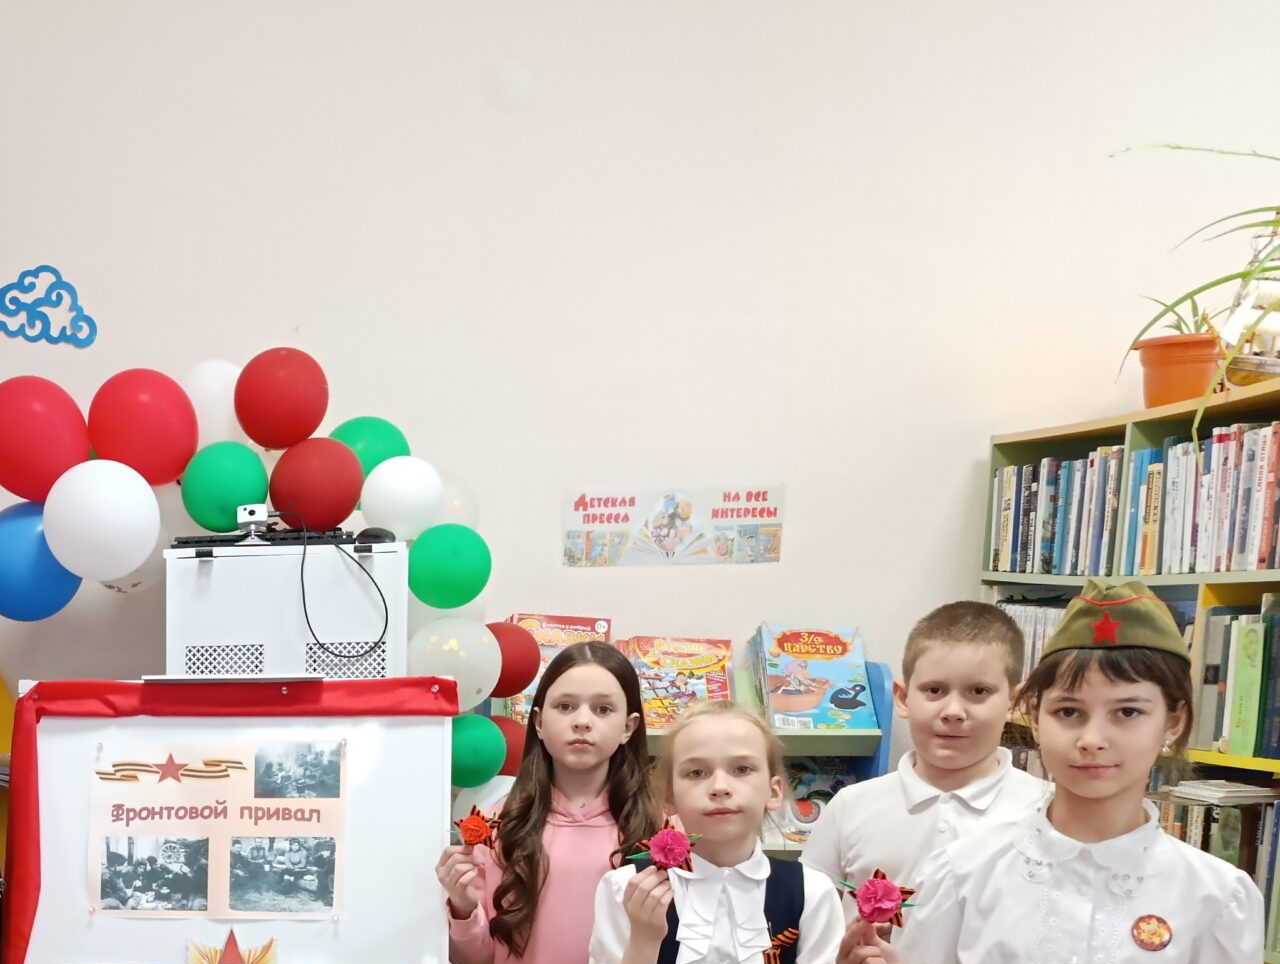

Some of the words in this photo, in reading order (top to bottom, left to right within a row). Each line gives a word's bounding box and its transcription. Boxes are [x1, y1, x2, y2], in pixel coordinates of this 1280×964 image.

[711, 507, 778, 520] ИНТЕРЕСЫ
[111, 799, 228, 827] Фронтовой
[239, 805, 321, 826] привал
